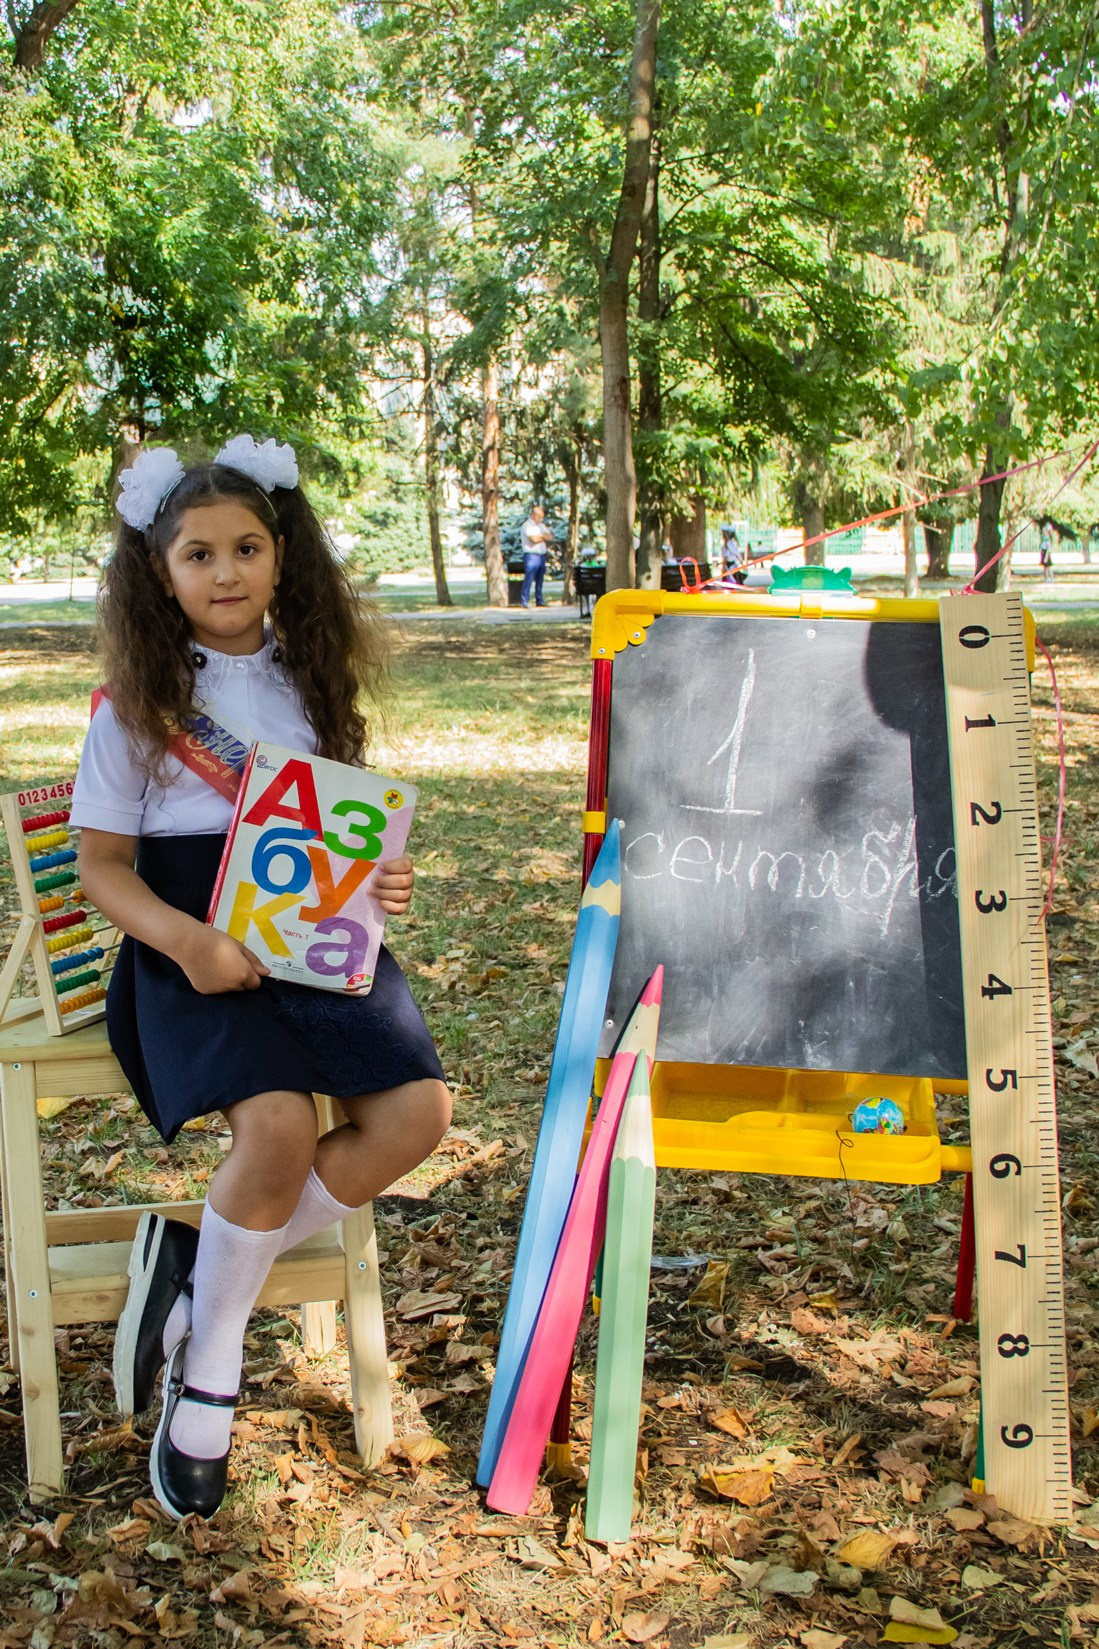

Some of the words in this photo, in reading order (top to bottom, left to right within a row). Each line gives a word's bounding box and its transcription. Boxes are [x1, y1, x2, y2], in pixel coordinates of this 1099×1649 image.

[959, 625, 990, 648] 0
[680, 648, 763, 816] 1
[964, 714, 996, 732] 1
[18, 781, 75, 806] 0123456
[970, 801, 1002, 826] 2
[975, 890, 1008, 914] 3
[283, 929, 303, 939] Часть
[981, 973, 1013, 1001] 4
[985, 1067, 1018, 1092] 5
[989, 1153, 1022, 1179] 6
[994, 1243, 1027, 1268] 7
[998, 1333, 1030, 1358] 8
[1001, 1423, 1034, 1449] 9
